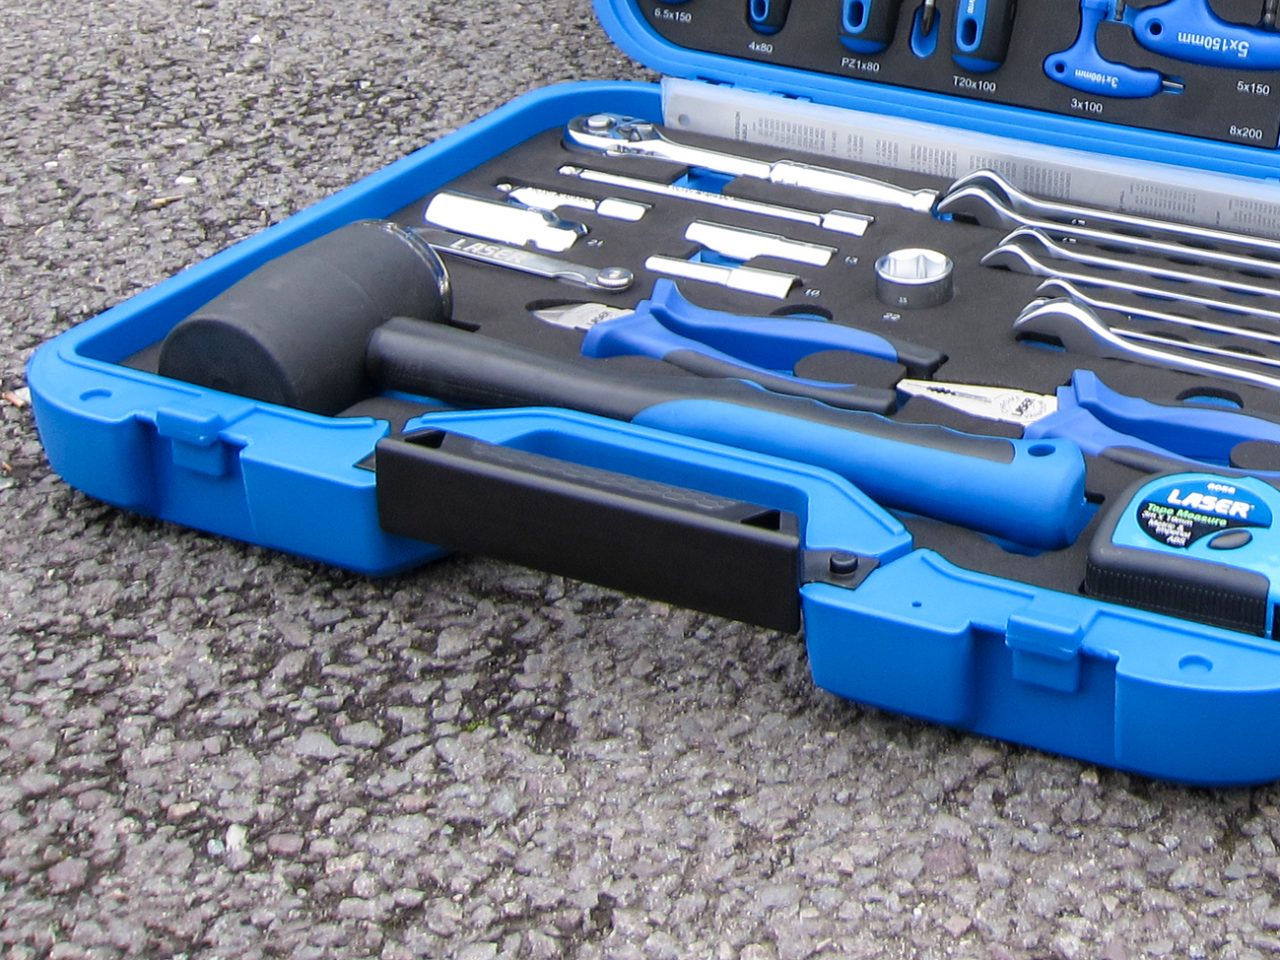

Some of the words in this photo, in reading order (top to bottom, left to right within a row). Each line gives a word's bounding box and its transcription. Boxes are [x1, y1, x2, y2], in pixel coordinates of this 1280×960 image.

[654, 8, 692, 23] 6.5x150
[748, 41, 773, 53] 4x80
[1178, 31, 1250, 58] 5x150mm
[841, 57, 880, 72] PZ1x80
[953, 75, 997, 92] T20x100
[1074, 68, 1119, 89] 3x100mm
[1236, 80, 1270, 95] 5x150
[1070, 98, 1103, 113] 3x100
[1229, 125, 1263, 140] 8x200
[450, 238, 527, 264] LASER
[1167, 488, 1251, 519] LASER
[1147, 502, 1174, 515] Tape
[1176, 508, 1228, 527] Measure
